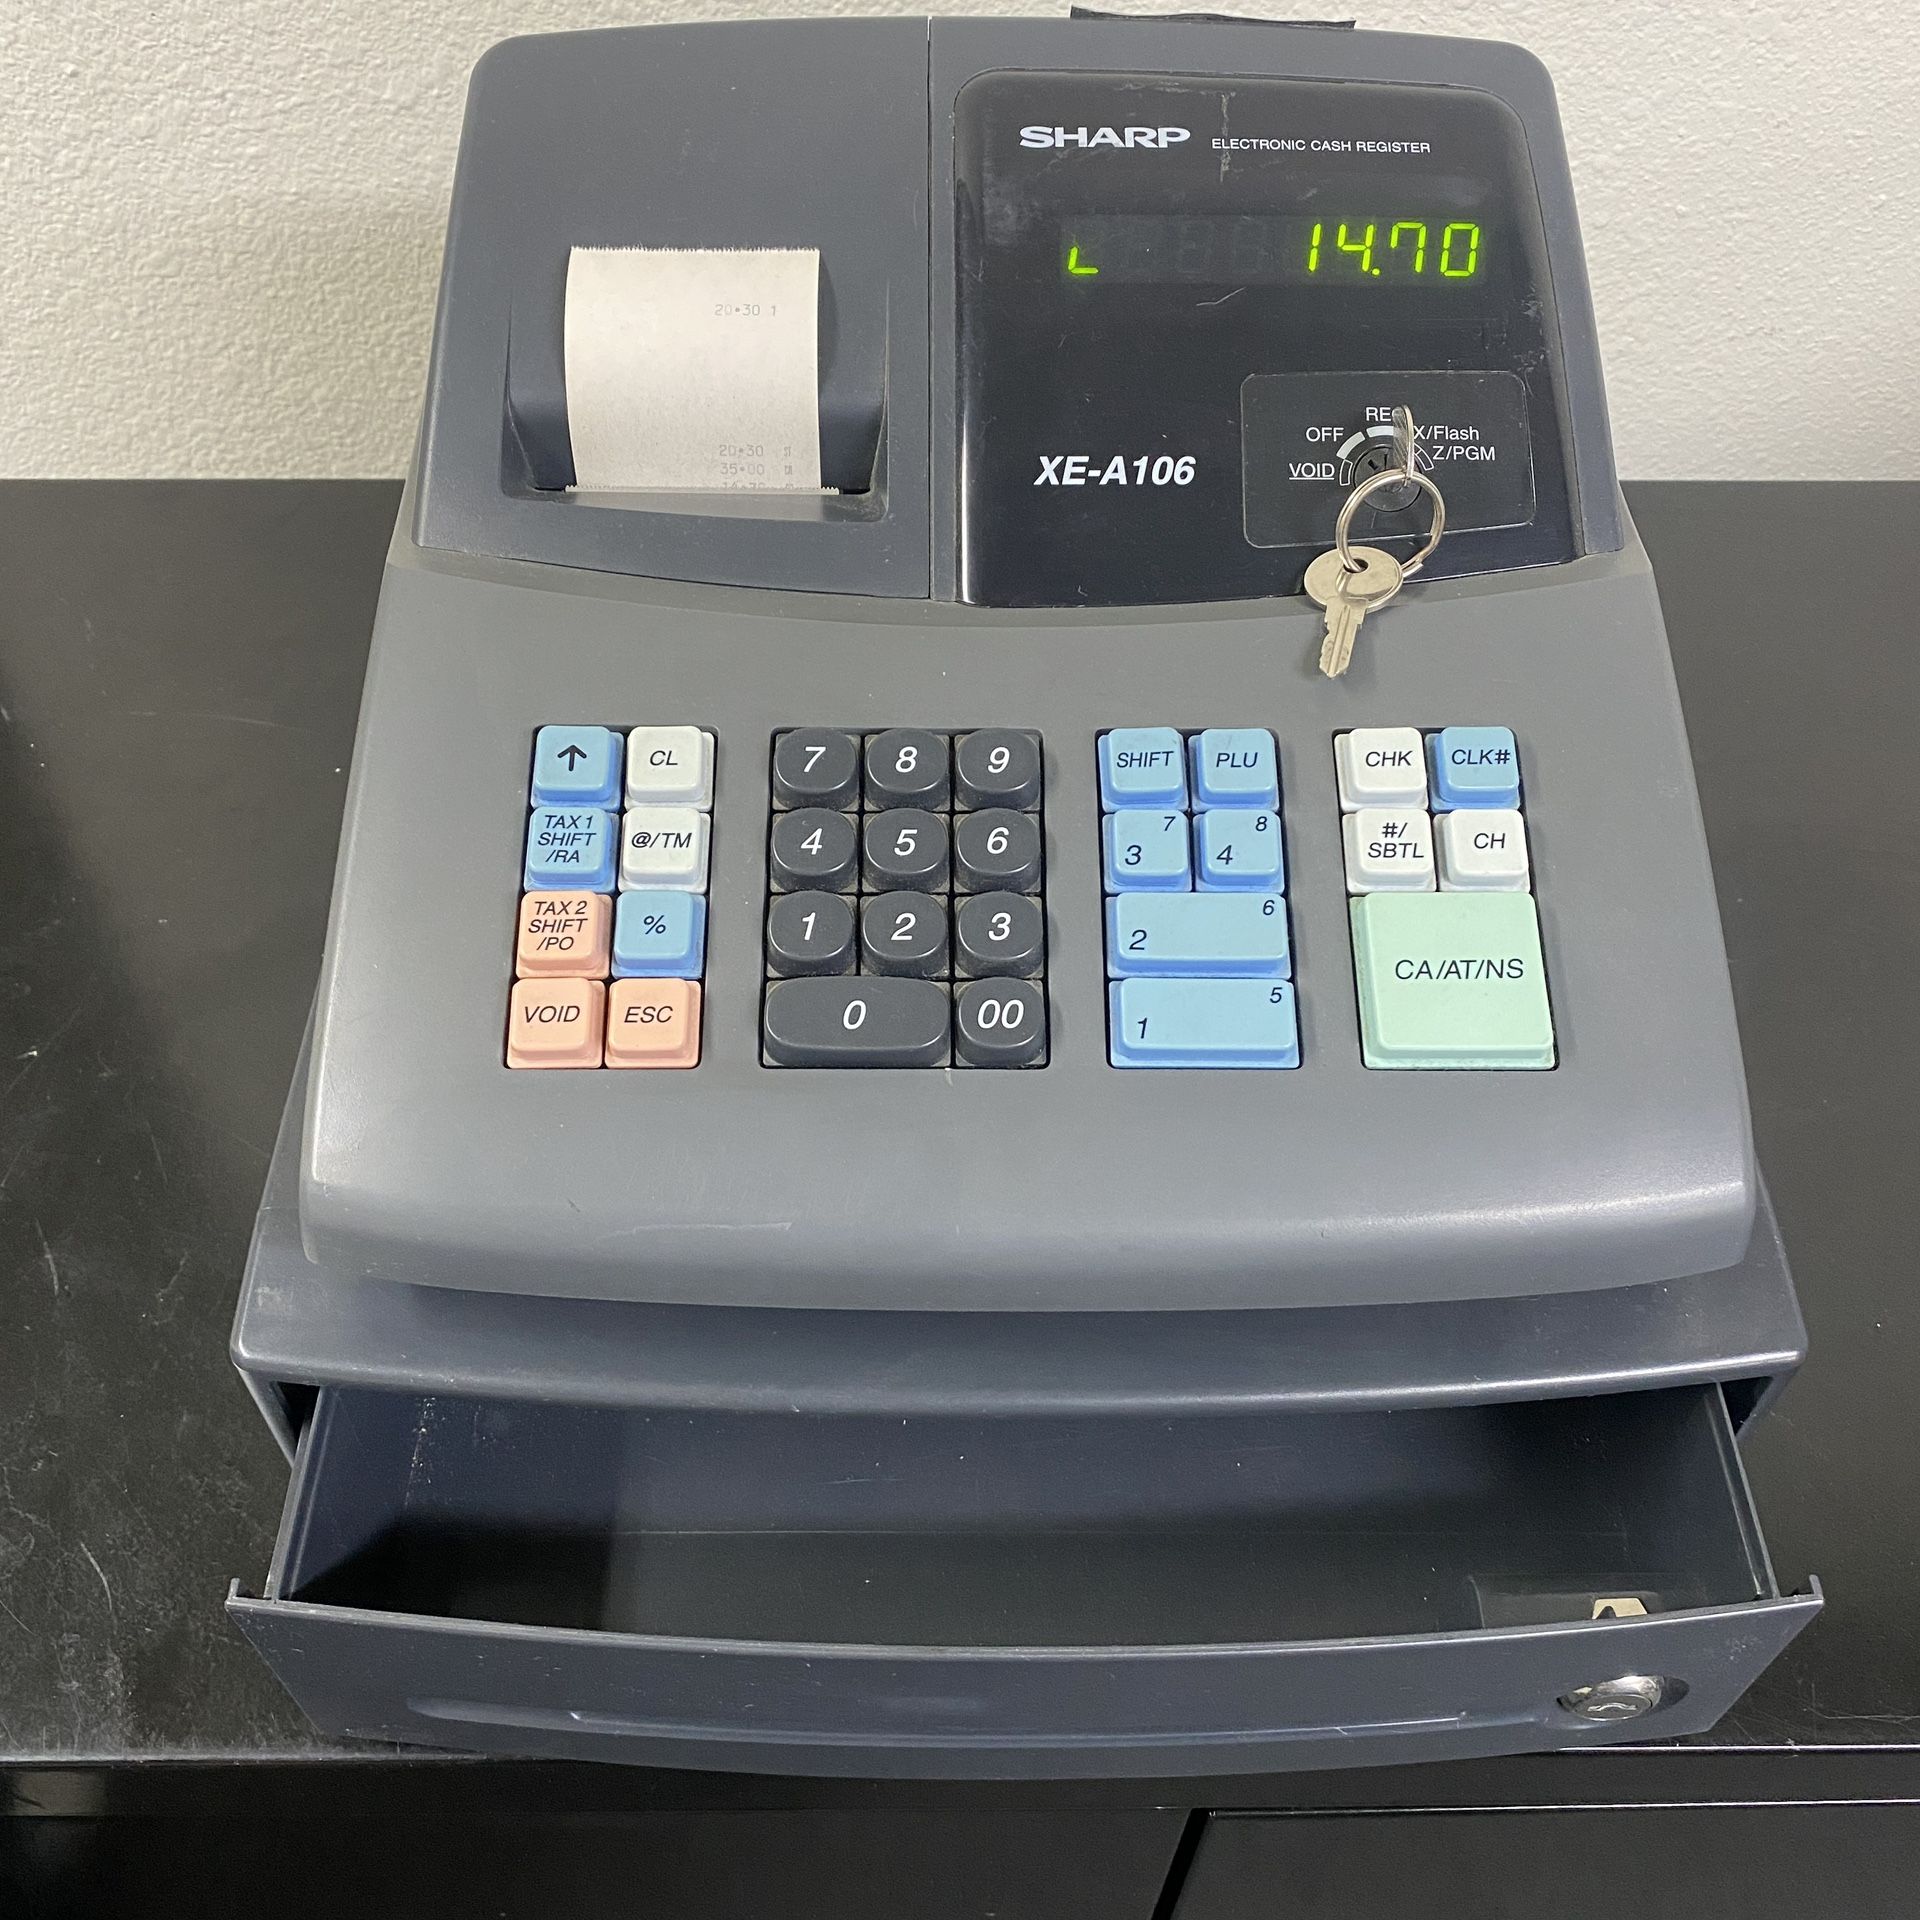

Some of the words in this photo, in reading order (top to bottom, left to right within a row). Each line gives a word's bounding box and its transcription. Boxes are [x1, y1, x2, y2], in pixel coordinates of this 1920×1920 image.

[1020, 126, 1190, 148] SHARP
[1212, 139, 1305, 150] ELECTRONIC
[1311, 140, 1351, 151] CASH
[1356, 142, 1430, 152] REGISTER
[1309, 223, 1479, 276] 14.70
[1365, 406, 1393, 422] RE
[1306, 427, 1343, 441] OFF
[1413, 425, 1479, 440] X/Flash
[1432, 446, 1495, 461] Z/PGM
[1034, 456, 1196, 485] XE-A106
[1289, 463, 1335, 478] VOID
[650, 751, 677, 765] CL
[804, 747, 826, 772] 7
[896, 747, 917, 772] 8
[988, 747, 1009, 773] 9
[1117, 751, 1173, 768] SHIFT
[1216, 752, 1257, 767] PLU
[1366, 751, 1412, 767] CHK
[1452, 750, 1510, 764] CLK#
[545, 815, 581, 829] TAX
[586, 816, 593, 828] 1
[1164, 816, 1176, 831] 7
[1256, 816, 1267, 831] 8
[1382, 823, 1407, 838] #/
[538, 832, 596, 846] SHIFT
[632, 832, 692, 848] @/TM
[801, 828, 822, 854] 4
[895, 830, 917, 856] 5
[987, 827, 1009, 854] 6
[1474, 833, 1505, 849] CH
[546, 850, 579, 862] /RA
[1125, 845, 1141, 865] 3
[1217, 845, 1233, 864] 4
[1368, 843, 1424, 858] SBTL
[535, 901, 572, 915] TAX
[575, 901, 587, 914] 2
[1263, 900, 1274, 915] 6
[529, 919, 588, 933] SHIFT
[644, 915, 666, 934] %
[803, 913, 815, 940] 1
[891, 913, 915, 940] 2
[989, 913, 1011, 940] 3
[537, 937, 574, 950] /PO
[1129, 930, 1146, 950] 2
[1396, 959, 1523, 979] CA/AT/NS
[1270, 987, 1282, 1003] 5
[525, 1006, 580, 1022] VOID
[624, 1006, 673, 1023] ESC
[844, 1001, 866, 1029] 0
[978, 1000, 1024, 1028] 00
[1138, 1018, 1147, 1038] 1
